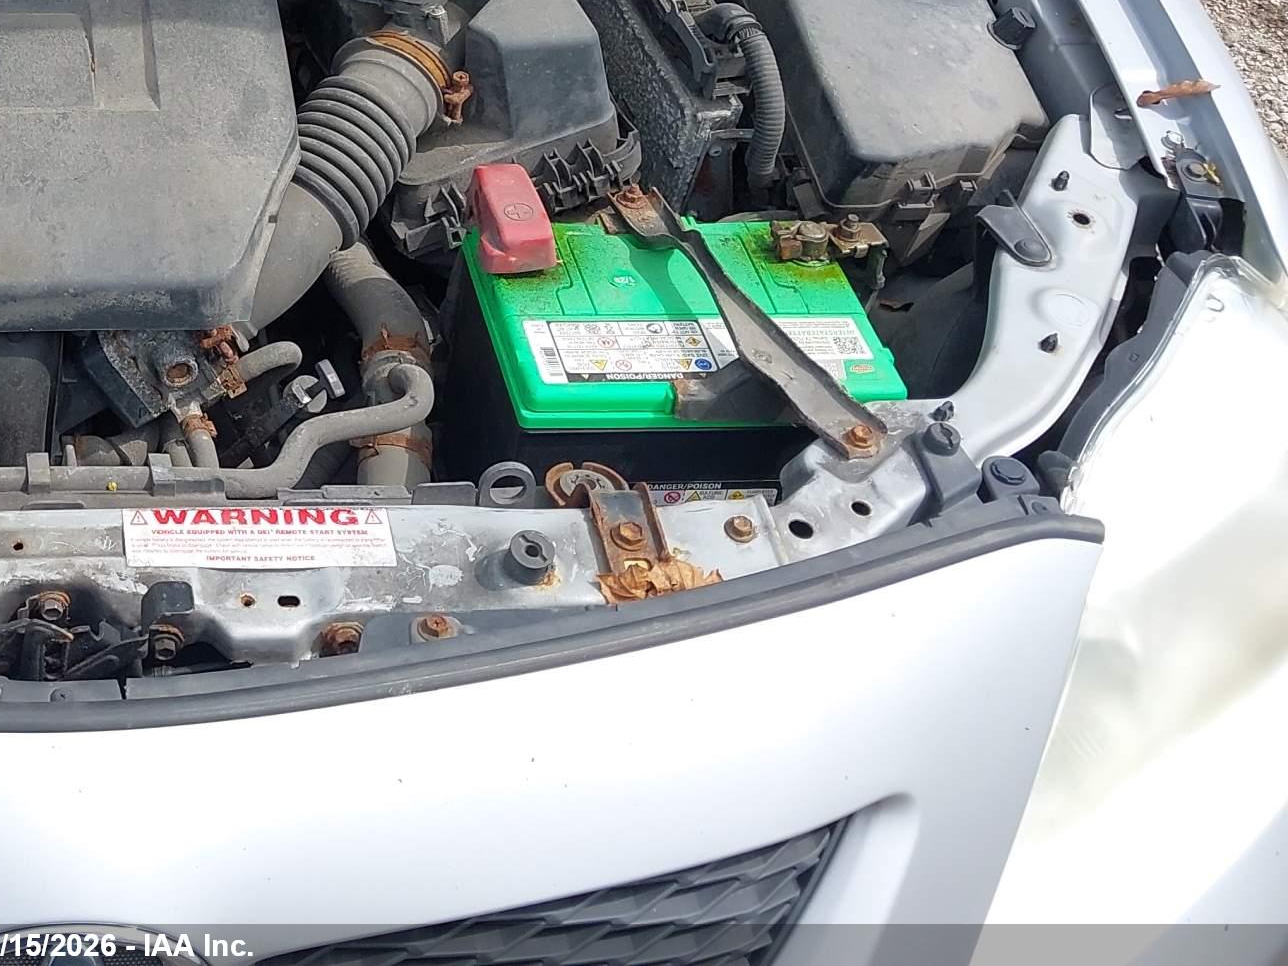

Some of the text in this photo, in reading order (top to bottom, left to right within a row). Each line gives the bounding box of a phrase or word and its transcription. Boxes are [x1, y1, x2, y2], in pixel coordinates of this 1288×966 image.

[605, 372, 684, 380] DANGER/POISON
[647, 482, 722, 490] DANGER/POISON
[153, 509, 359, 525] WARNING
